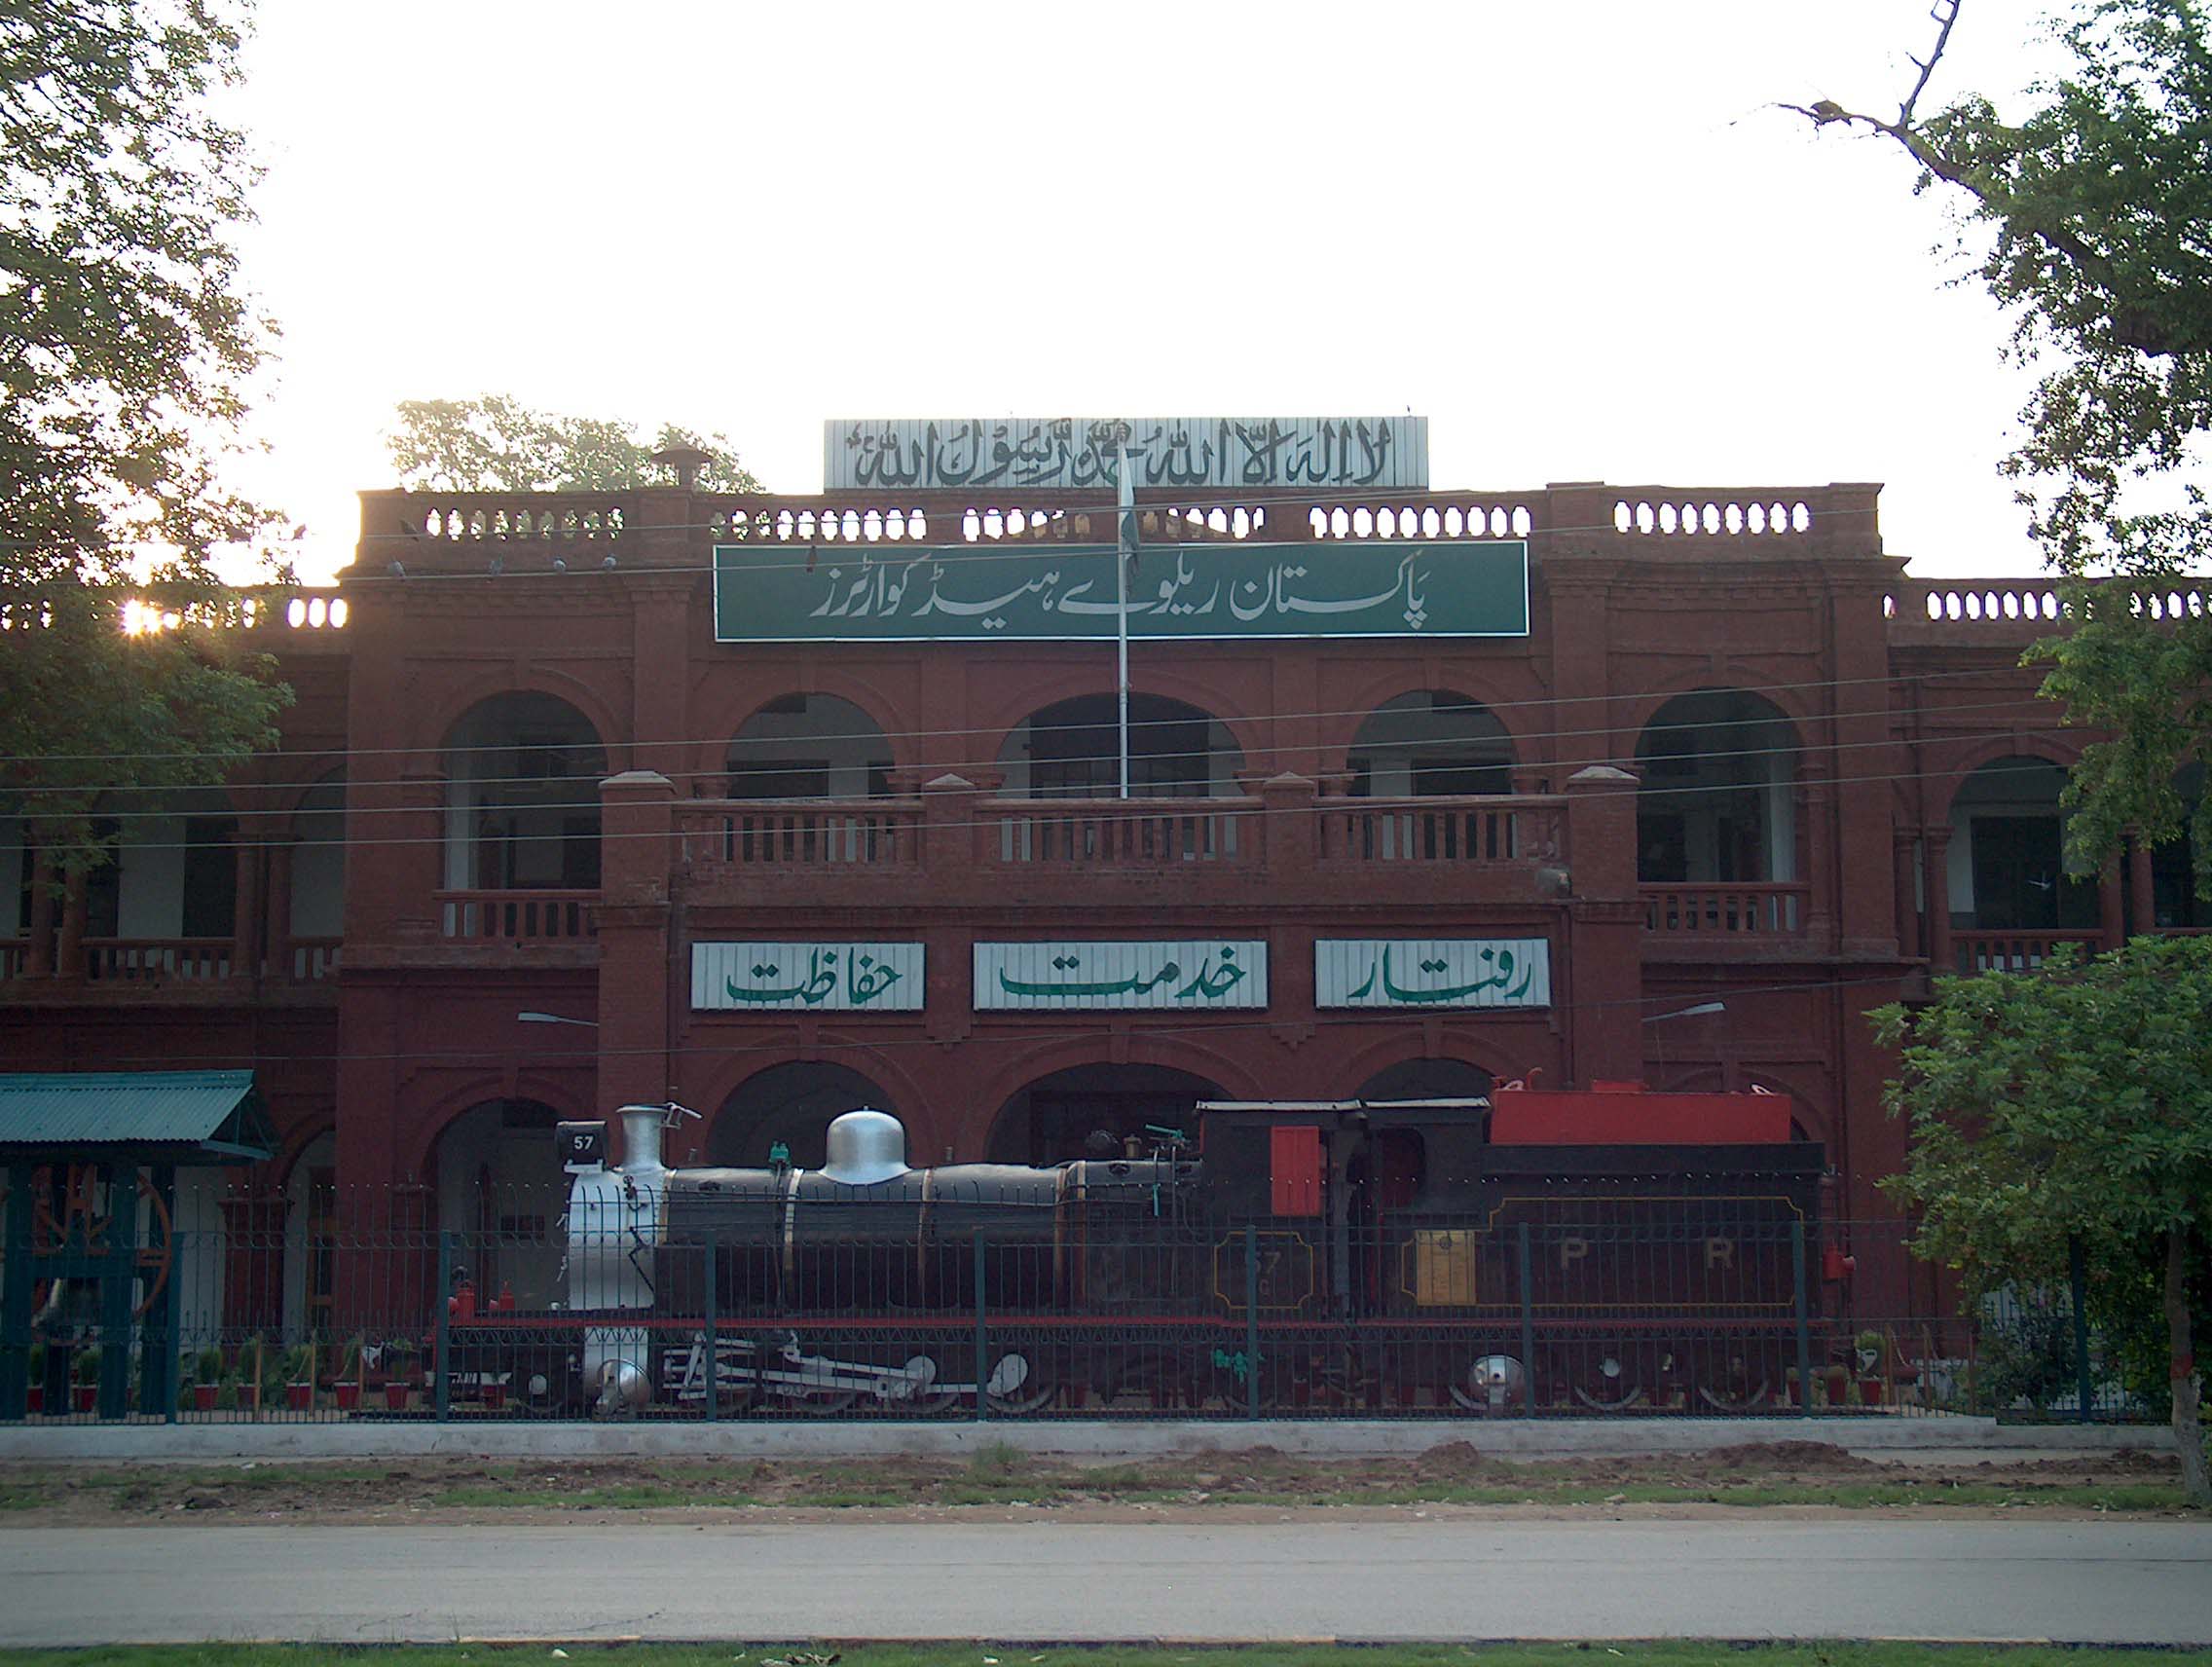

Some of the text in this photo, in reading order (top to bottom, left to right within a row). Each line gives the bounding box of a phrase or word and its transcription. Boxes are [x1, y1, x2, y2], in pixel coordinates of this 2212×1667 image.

[910, 562, 1060, 629] ہیڈ
[1056, 548, 1220, 616] ریلوے
[1229, 548, 1431, 630] پاکستان
[726, 946, 903, 1005] حفاظت
[999, 945, 1246, 999] خدمت
[1347, 943, 1531, 1003] رفتار
[574, 1135, 594, 1150] 57
[1560, 1237, 1734, 1271] P R
